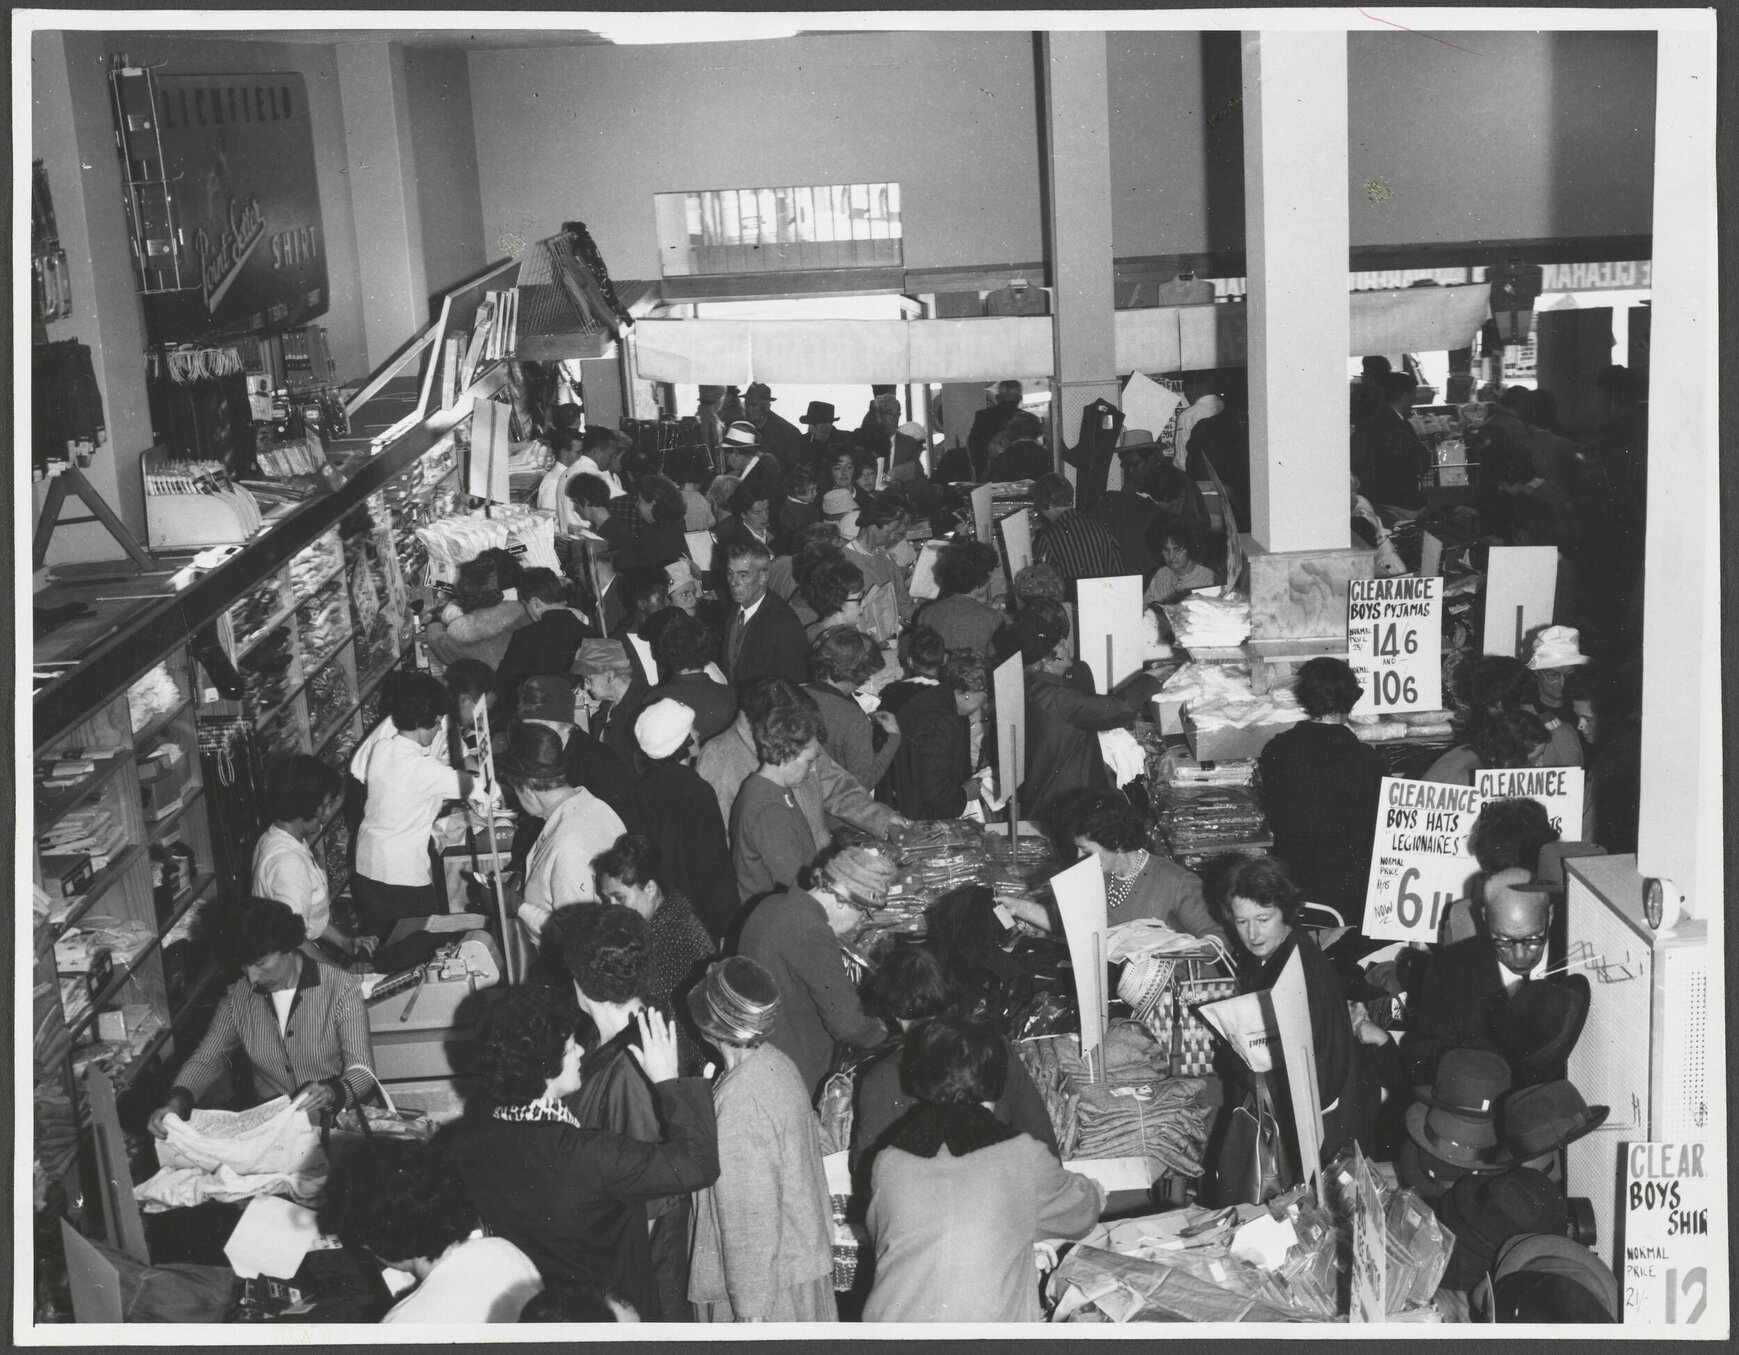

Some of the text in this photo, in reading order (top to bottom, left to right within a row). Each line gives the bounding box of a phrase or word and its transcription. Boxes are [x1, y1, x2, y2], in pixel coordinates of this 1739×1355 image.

[272, 226, 317, 269] SHIRT
[1351, 578, 1435, 601] CLEARANCE
[1350, 602, 1431, 621] BOYS PYJAMAS
[1383, 658, 1397, 666] AND
[1480, 769, 1567, 798] CLEARANCE
[1389, 782, 1480, 814] CLEARANCE
[1386, 809, 1459, 832] BOYS HATS
[1380, 856, 1404, 866] NORMAL
[1380, 866, 1399, 876] PRICE
[1374, 902, 1393, 918] NOW
[1630, 1143, 1707, 1179] CLEAR
[1630, 1180, 1681, 1211] BOYS
[1627, 1246, 1669, 1260] NORMAL
[1627, 1264, 1656, 1278] PRICE
